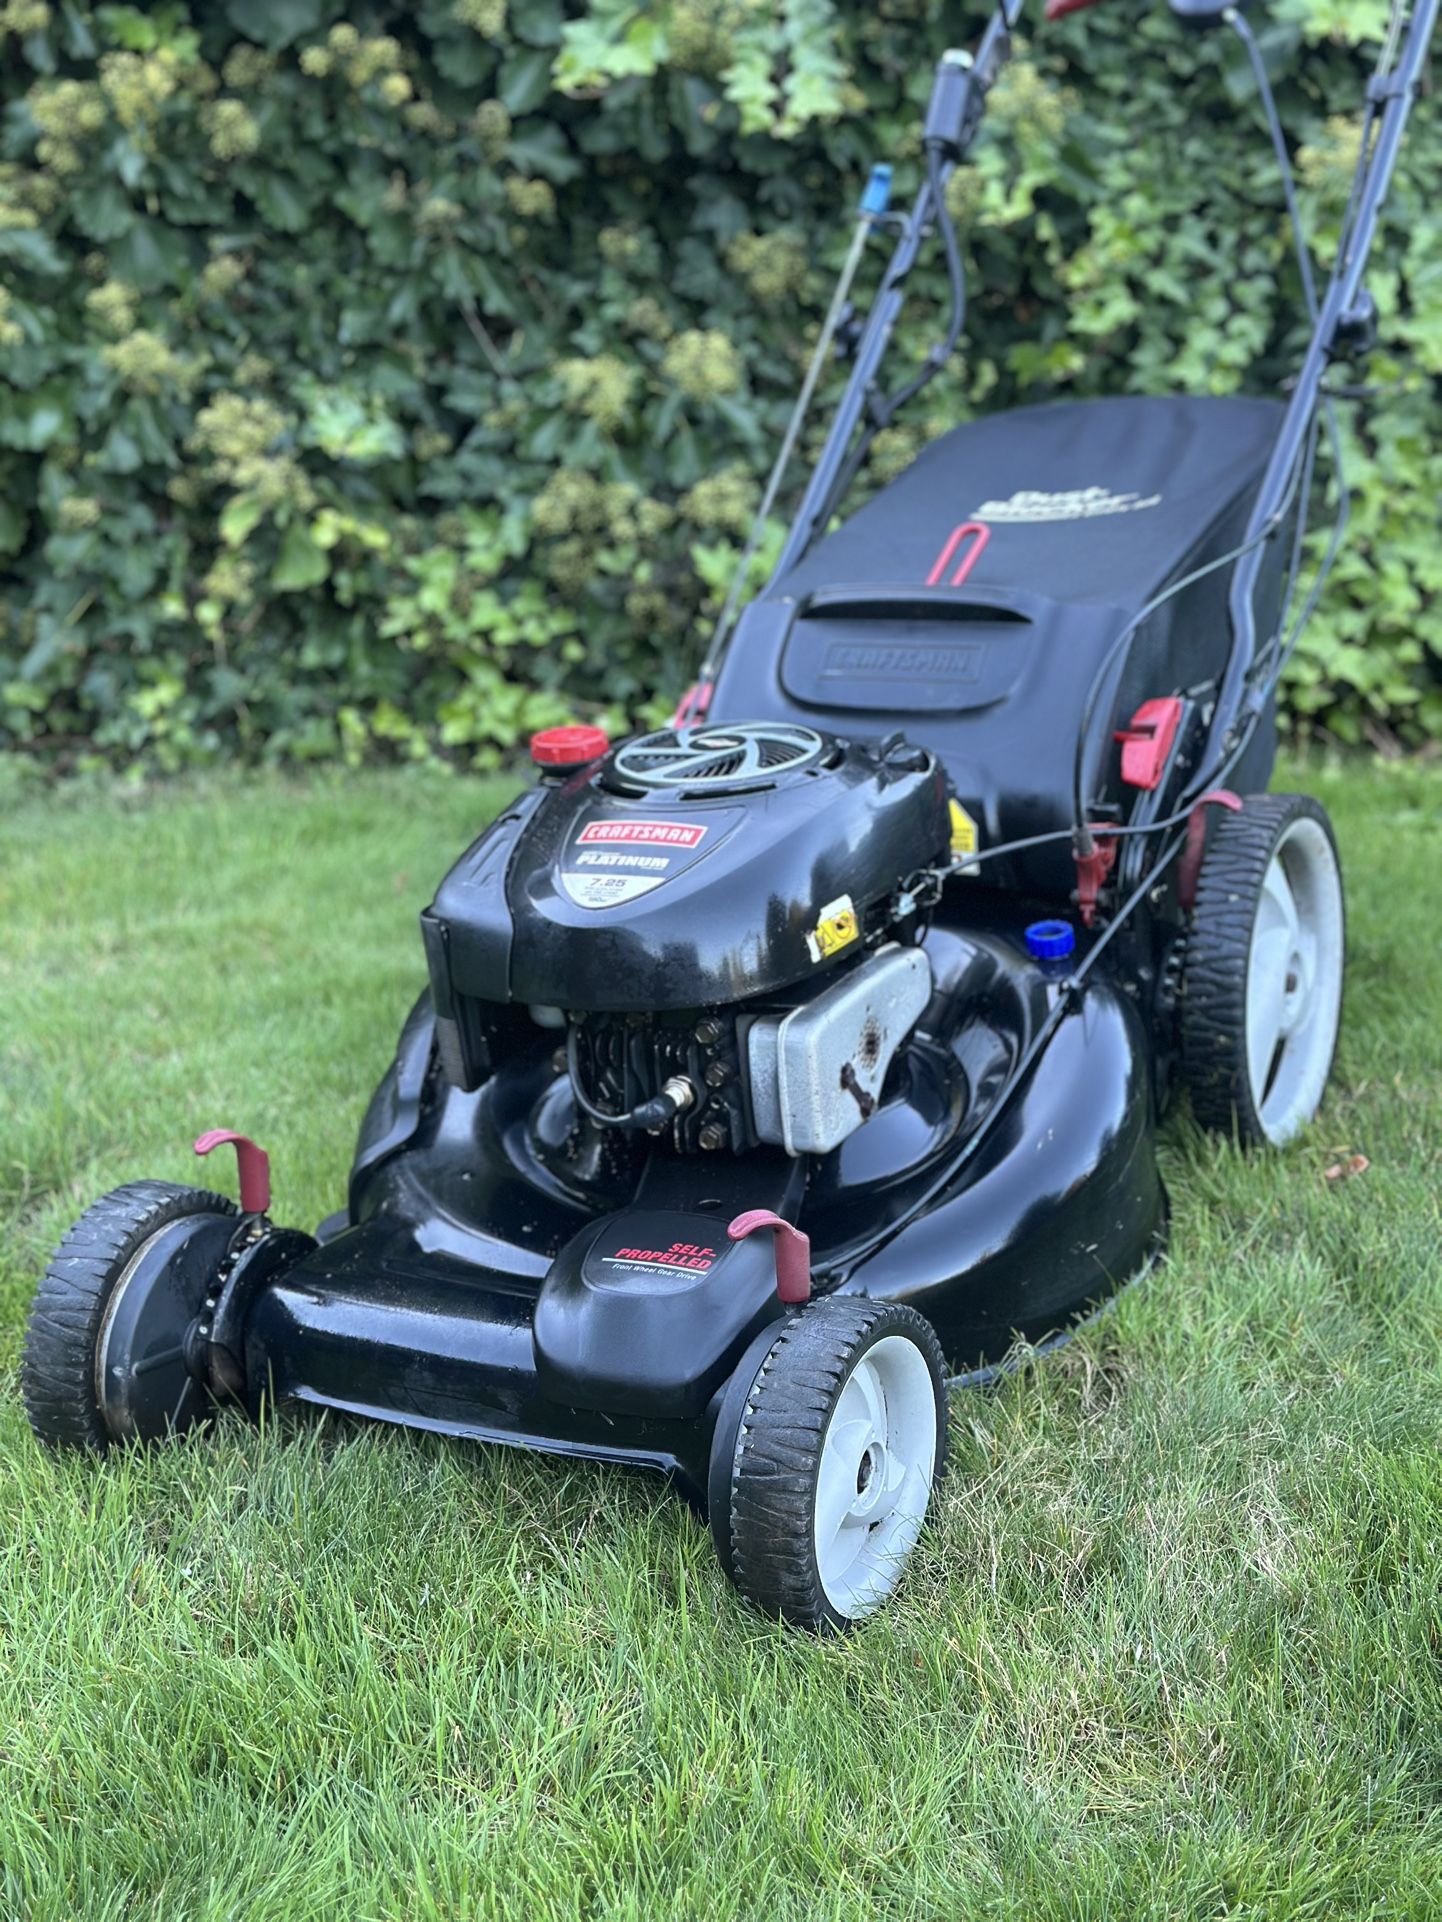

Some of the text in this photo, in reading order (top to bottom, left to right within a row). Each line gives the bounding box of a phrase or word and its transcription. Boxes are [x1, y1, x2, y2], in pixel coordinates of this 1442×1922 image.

[587, 825, 695, 841] CRAFTSMAN
[575, 852, 670, 869] PLATINUM
[590, 878, 627, 887] 7.25
[668, 1243, 717, 1257] SELF-
[615, 1248, 712, 1269] PROPELLED
[612, 1263, 697, 1280] Front Wheel Gear Drive
